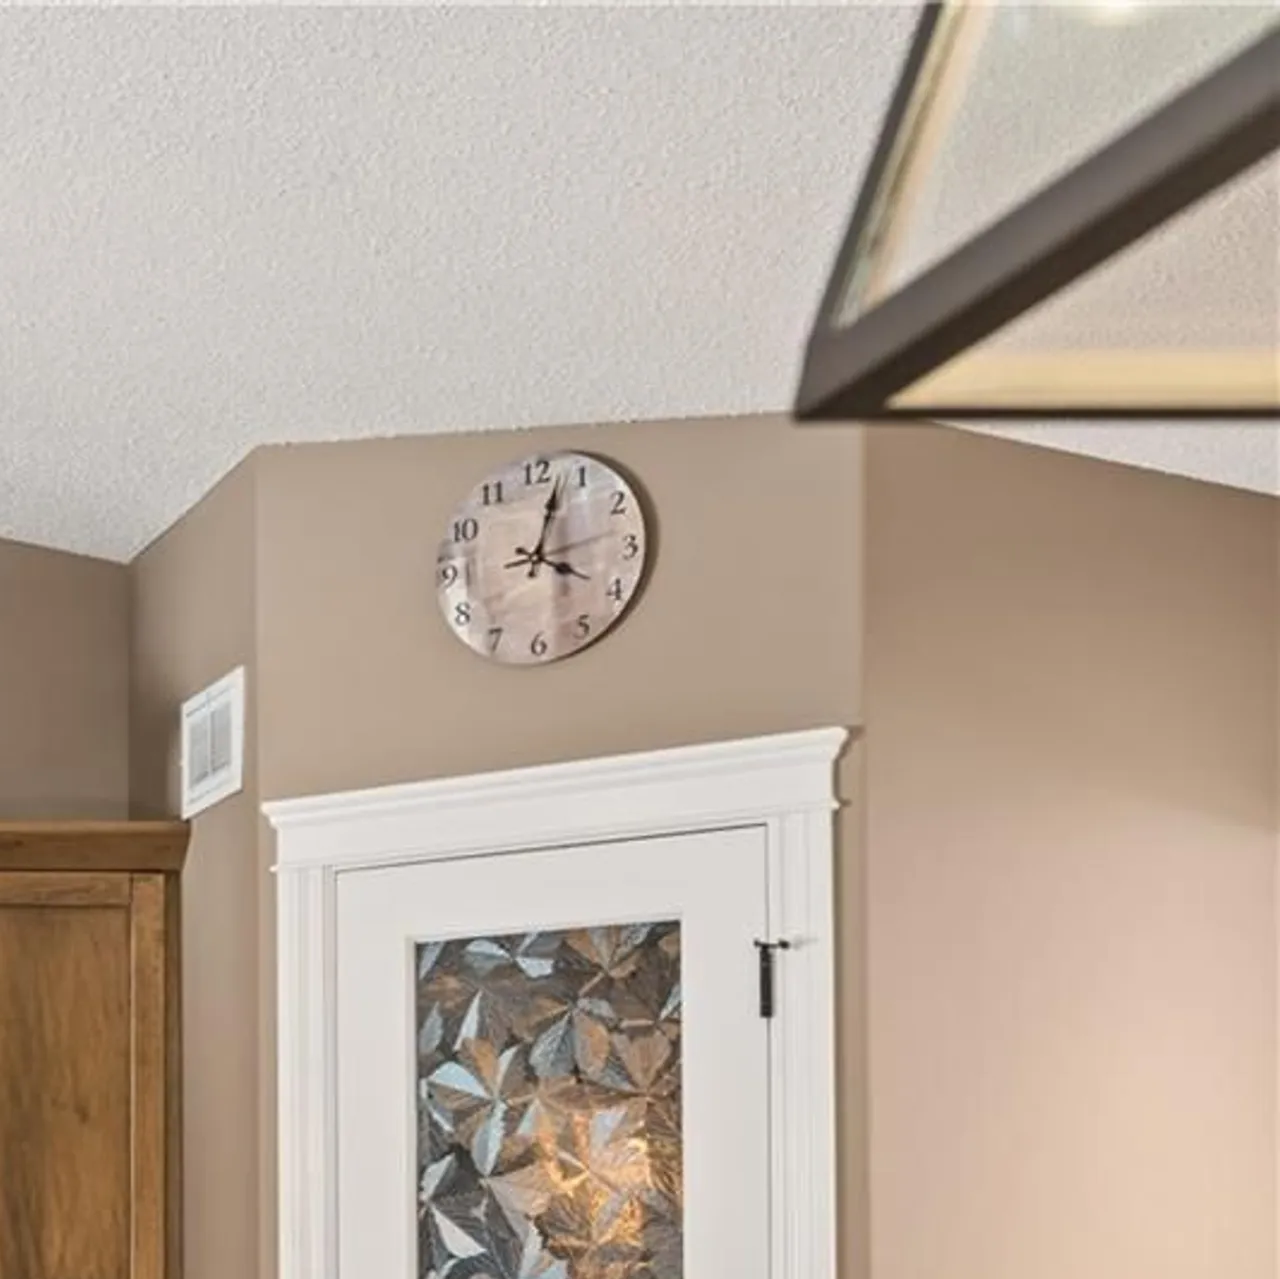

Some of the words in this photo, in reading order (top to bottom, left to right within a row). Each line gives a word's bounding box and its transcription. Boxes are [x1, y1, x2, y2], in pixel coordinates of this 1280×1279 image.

[523, 460, 551, 486] 12
[576, 465, 587, 488] 1
[482, 481, 504, 505] 11
[610, 491, 626, 515] 2
[453, 518, 479, 543] 10
[622, 534, 639, 560] 3
[441, 565, 458, 588] 9
[606, 577, 623, 601] 4
[454, 602, 471, 626] 8
[576, 614, 590, 639] 5
[488, 627, 503, 652] 7
[530, 632, 547, 656] 6
